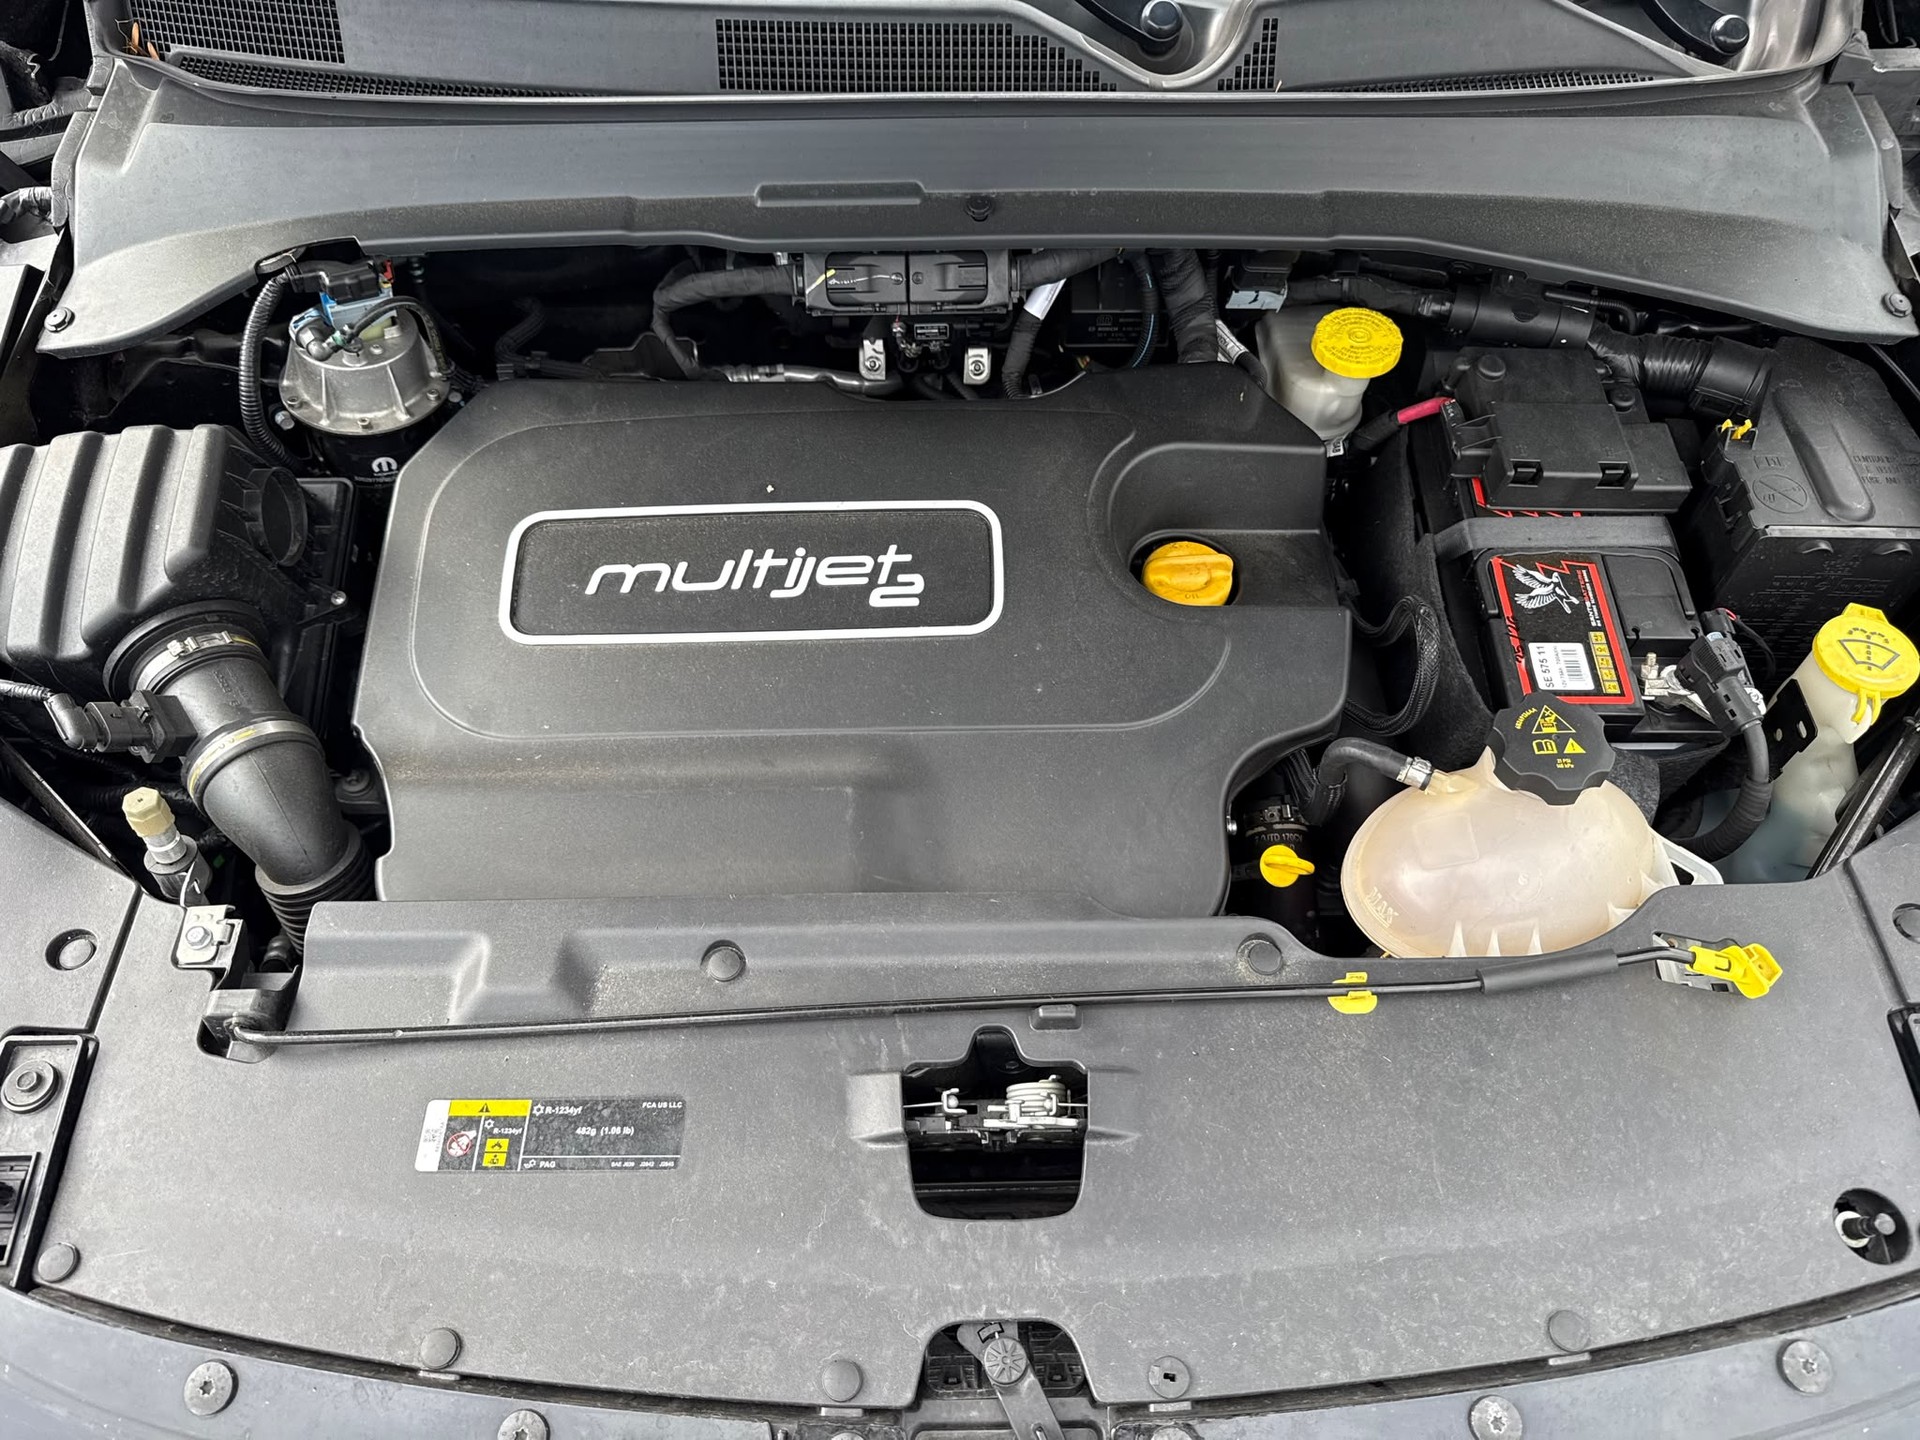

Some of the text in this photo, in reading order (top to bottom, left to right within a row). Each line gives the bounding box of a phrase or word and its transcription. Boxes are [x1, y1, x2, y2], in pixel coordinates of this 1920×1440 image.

[584, 544, 913, 599] multijet
[1536, 645, 1555, 688] SE 575 11
[1366, 886, 1399, 924] MAX
[545, 1105, 583, 1116] R-1234yf
[642, 1101, 683, 1109] FCA US LLC
[493, 1127, 523, 1136] R-1234yf
[539, 1160, 556, 1169] PAG
